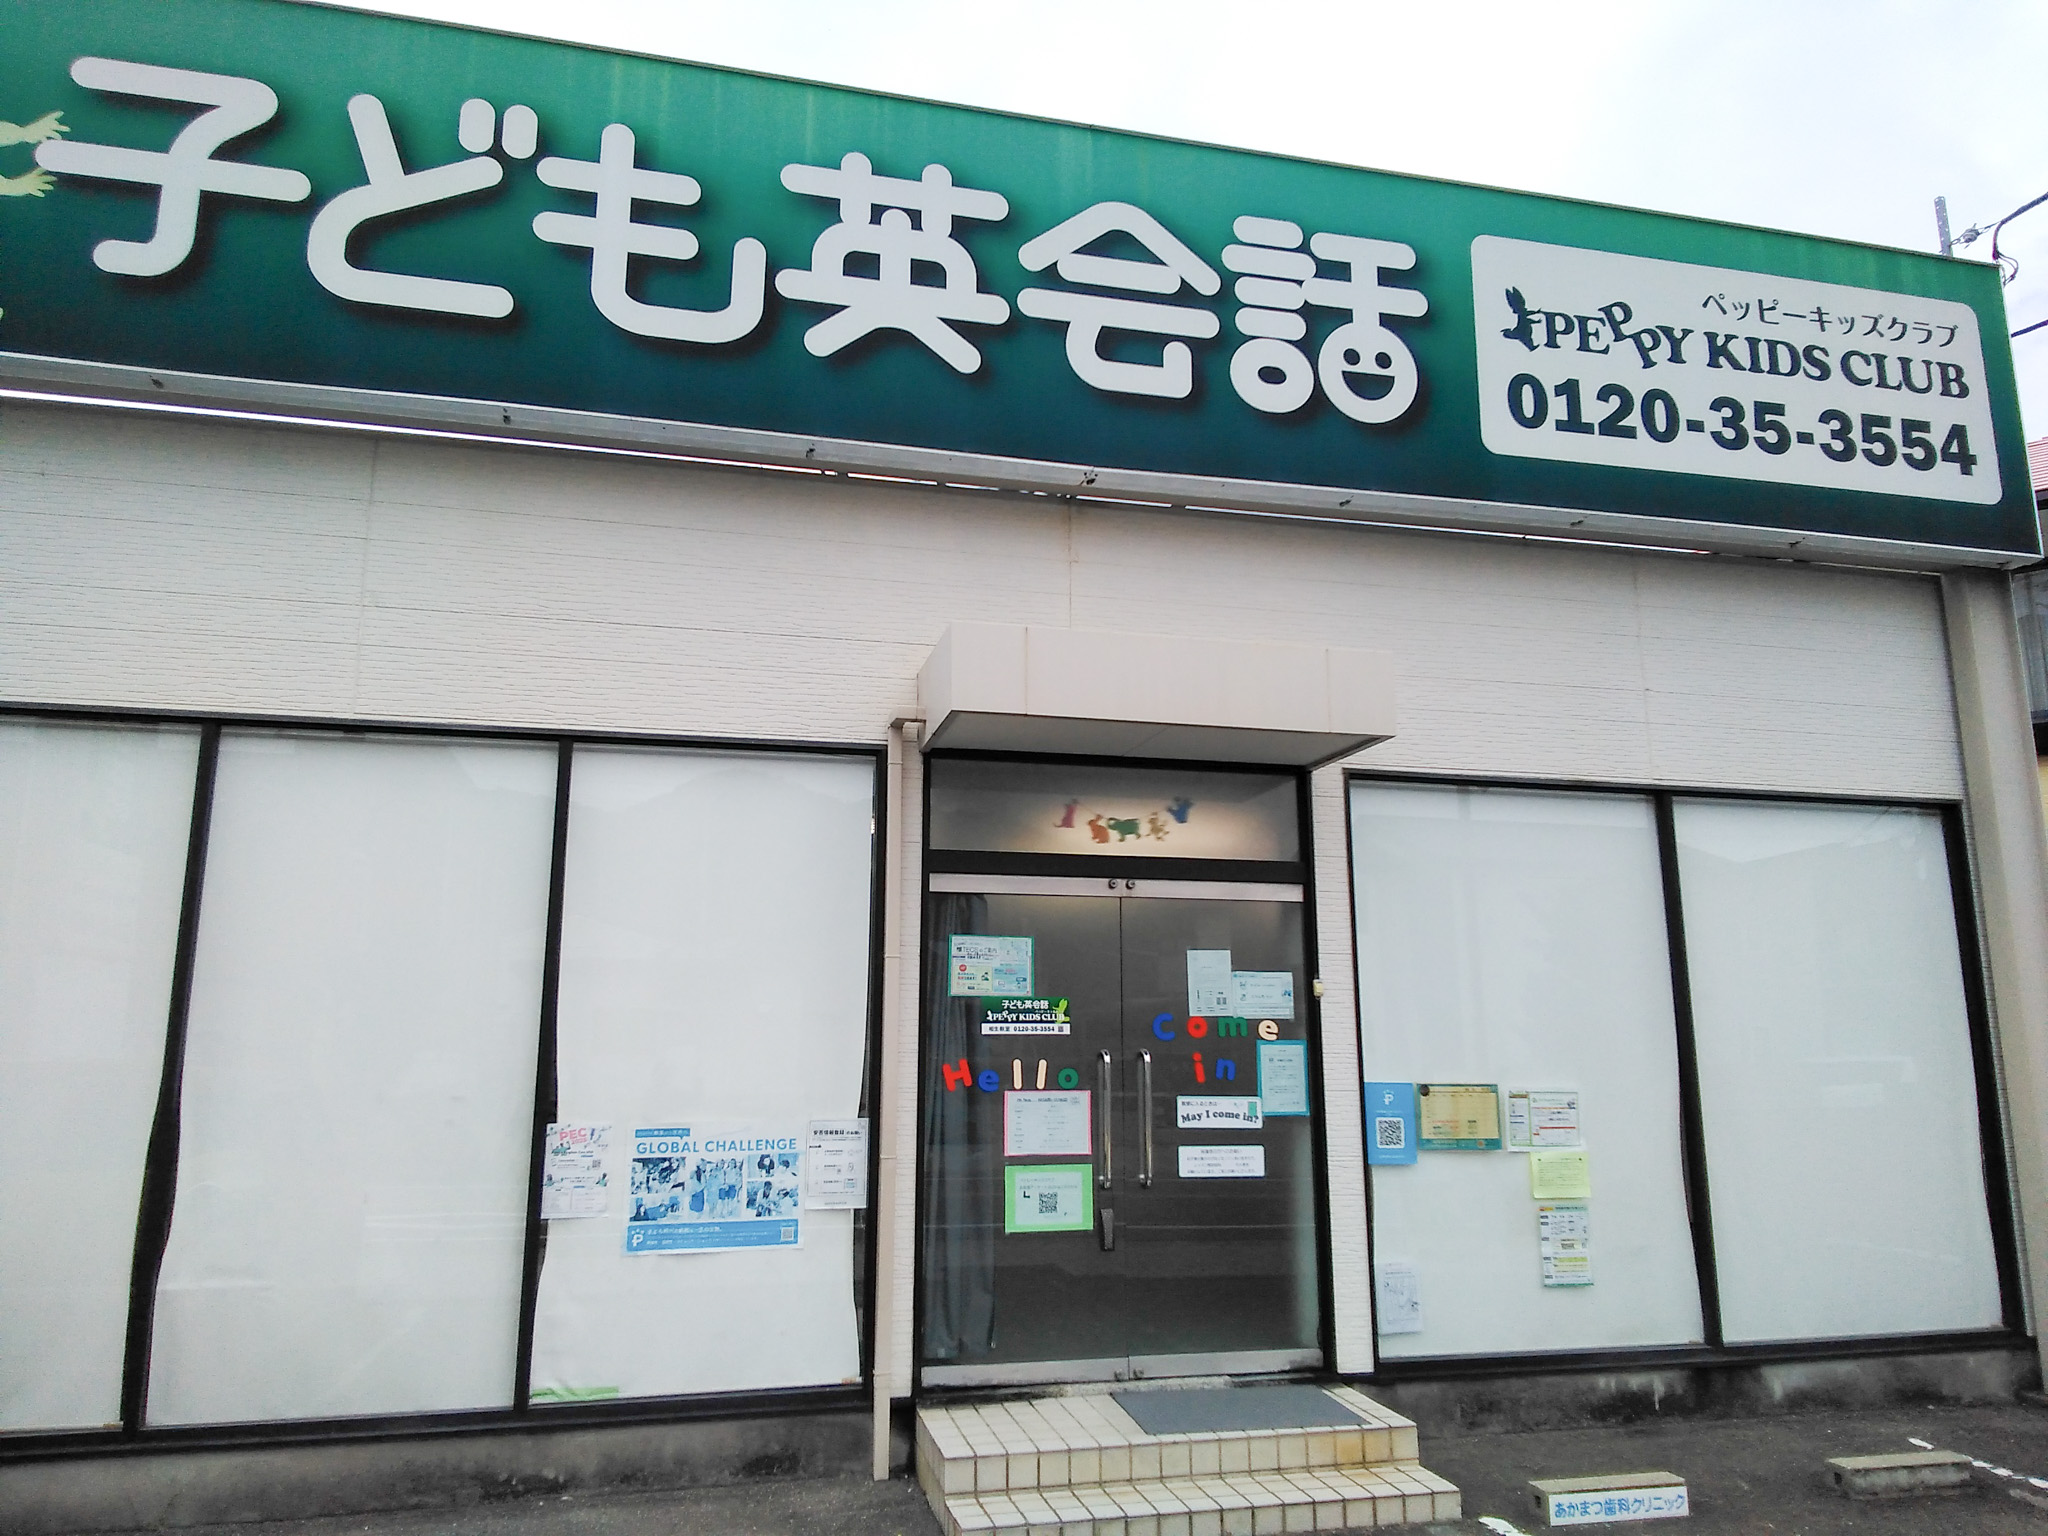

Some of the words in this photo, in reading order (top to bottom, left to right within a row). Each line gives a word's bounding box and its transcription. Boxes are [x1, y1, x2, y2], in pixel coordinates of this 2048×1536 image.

[34, 55, 1428, 424] 子ども英会話
[1702, 291, 1959, 348] ペッピーキッズクラブ
[1543, 300, 1695, 370] PEPPY
[1705, 331, 1832, 382] KIDS
[1840, 349, 1971, 400] CLUB
[1506, 373, 1978, 477] 0120-35-3554
[993, 1010, 1018, 1022] PEPPY
[1019, 1013, 1041, 1021] KIDS
[1041, 1013, 1065, 1021] CLUB
[1002, 1000, 1049, 1009] 子ども英会話
[942, 1058, 1079, 1092] Hello
[1192, 1052, 1237, 1083] in
[1181, 1112, 1203, 1124] May
[1205, 1109, 1210, 1119] I
[1212, 1111, 1241, 1119] come
[560, 1127, 587, 1141] PEC
[636, 1141, 700, 1154] GLOBAL
[704, 1138, 797, 1152] CHALLENGE
[1554, 1494, 1686, 1519] あかまつ歯科クリニック
